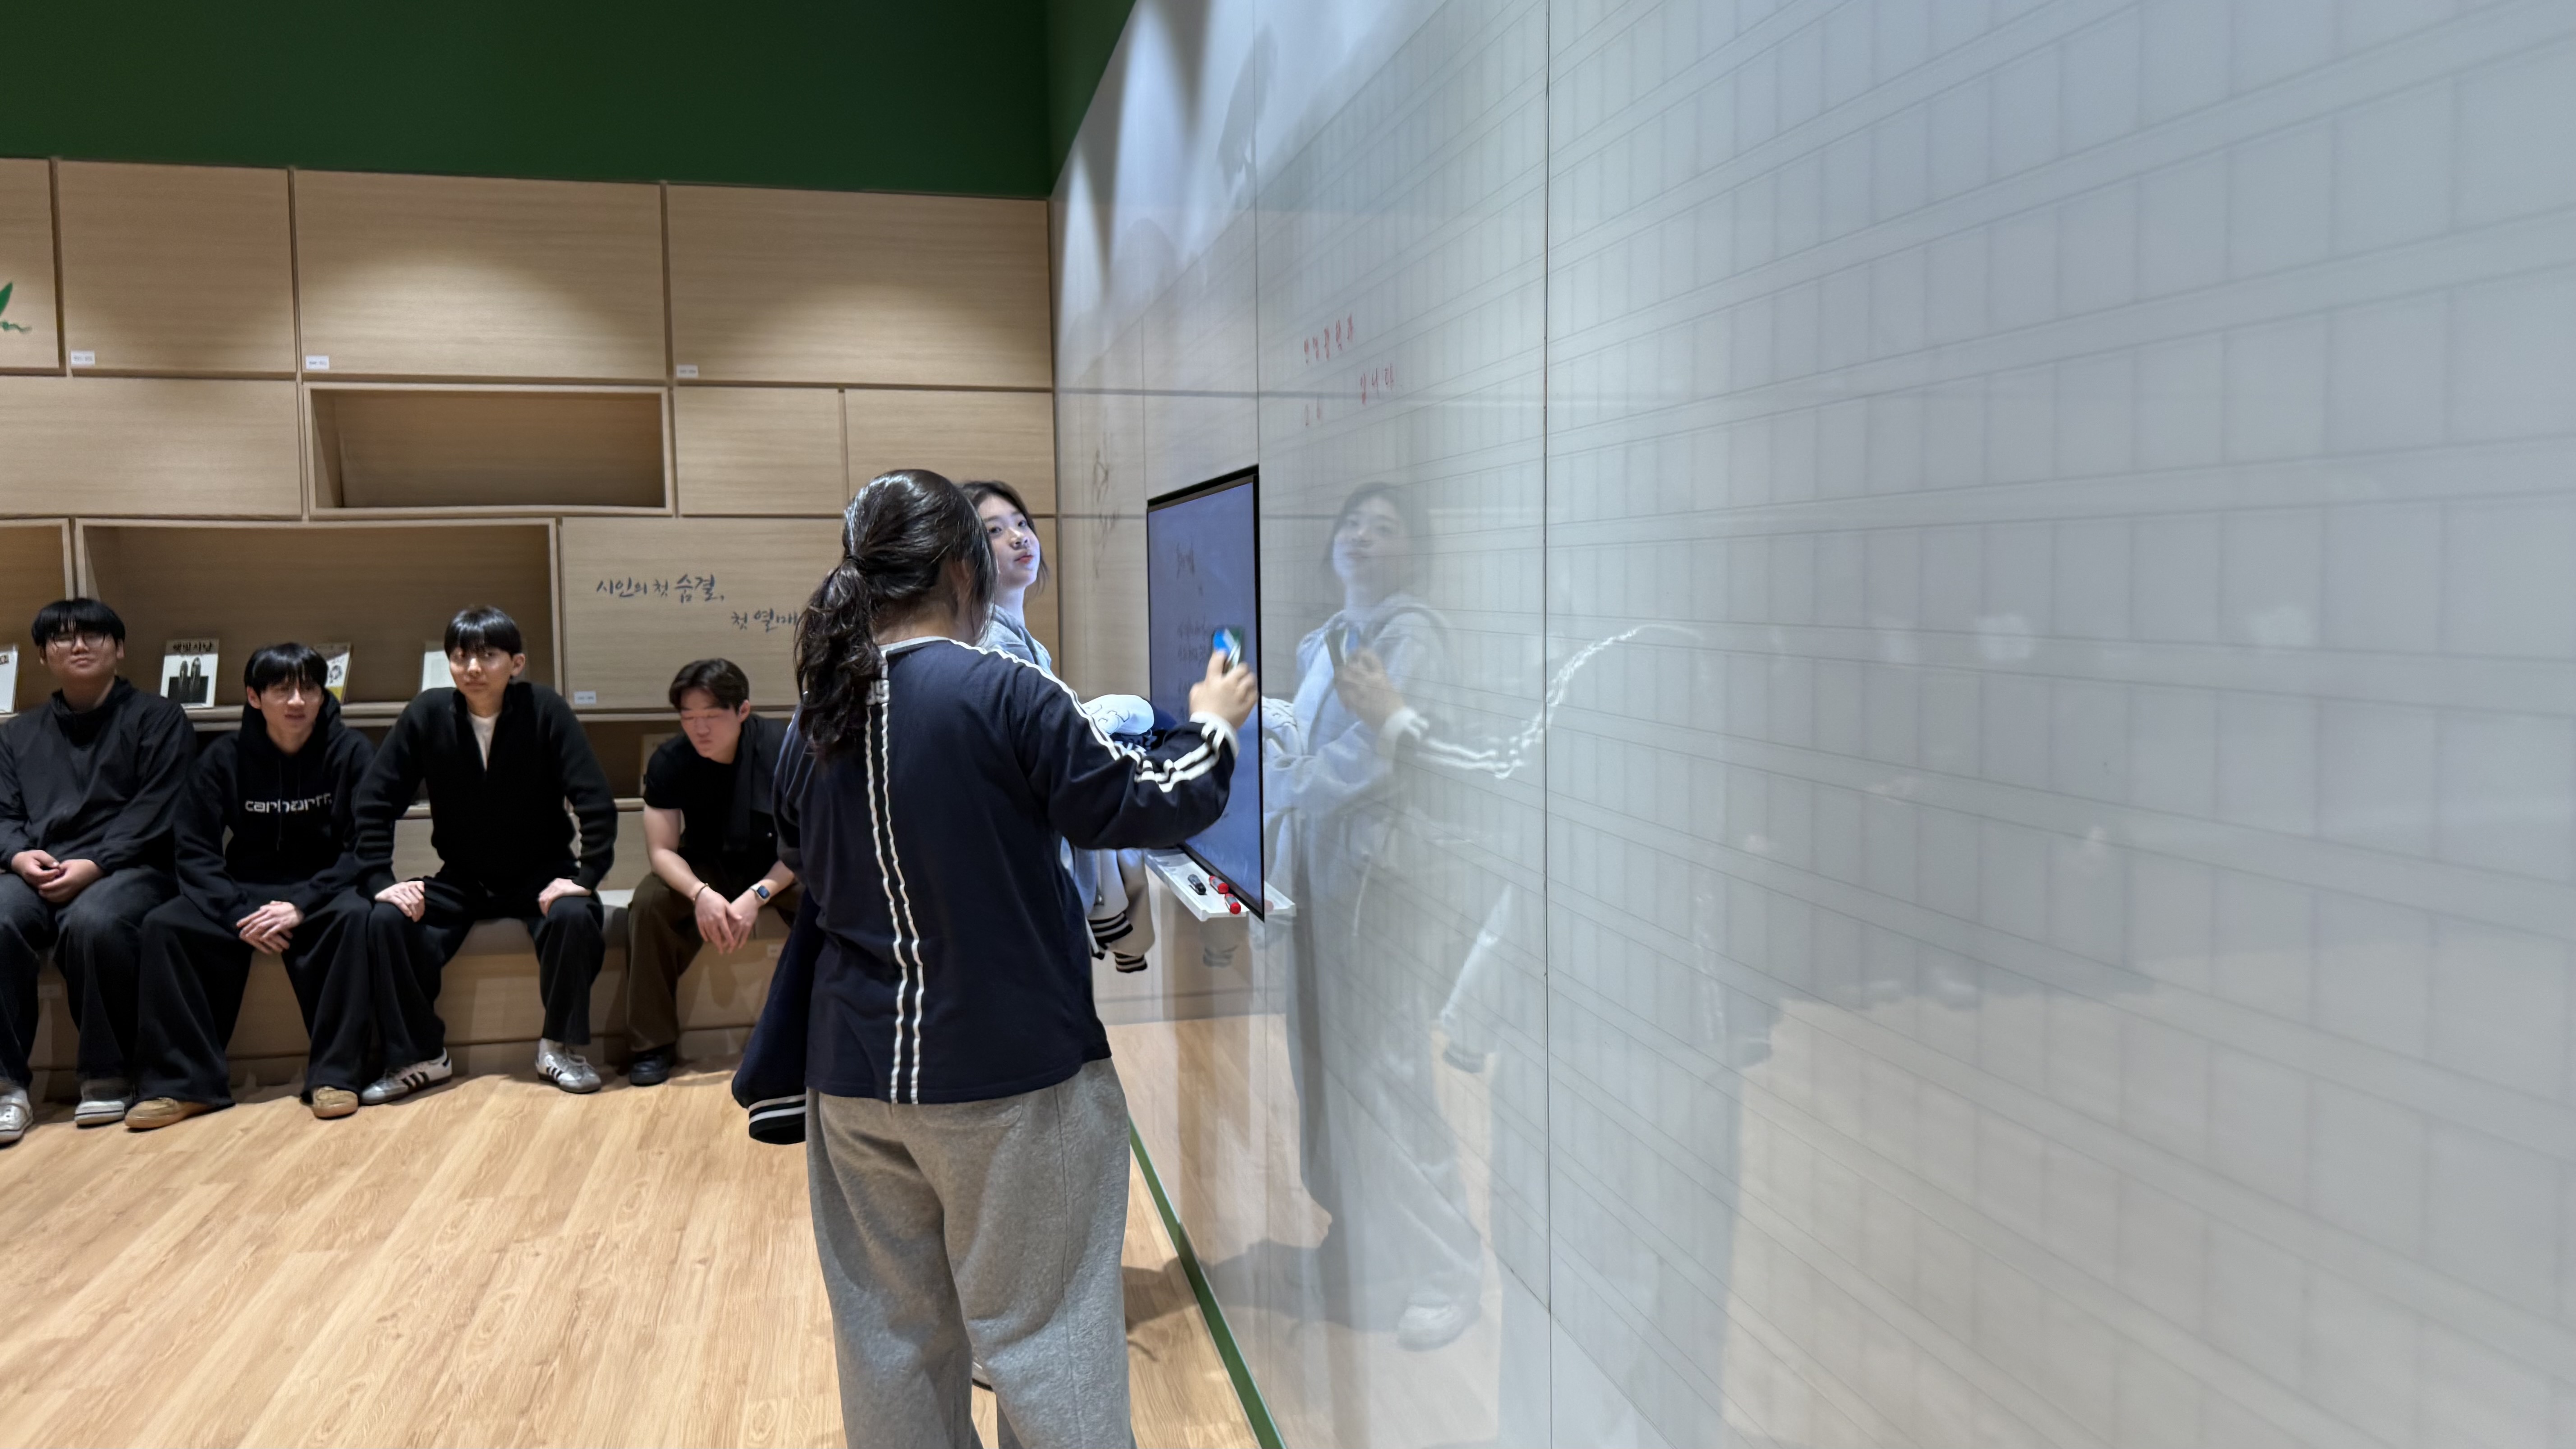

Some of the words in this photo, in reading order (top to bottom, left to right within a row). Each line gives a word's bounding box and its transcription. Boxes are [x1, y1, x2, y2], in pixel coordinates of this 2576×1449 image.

[596, 577, 648, 598] 시인의
[653, 579, 669, 596] 첫
[731, 611, 748, 630] 첫
[754, 607, 798, 632] 열매
